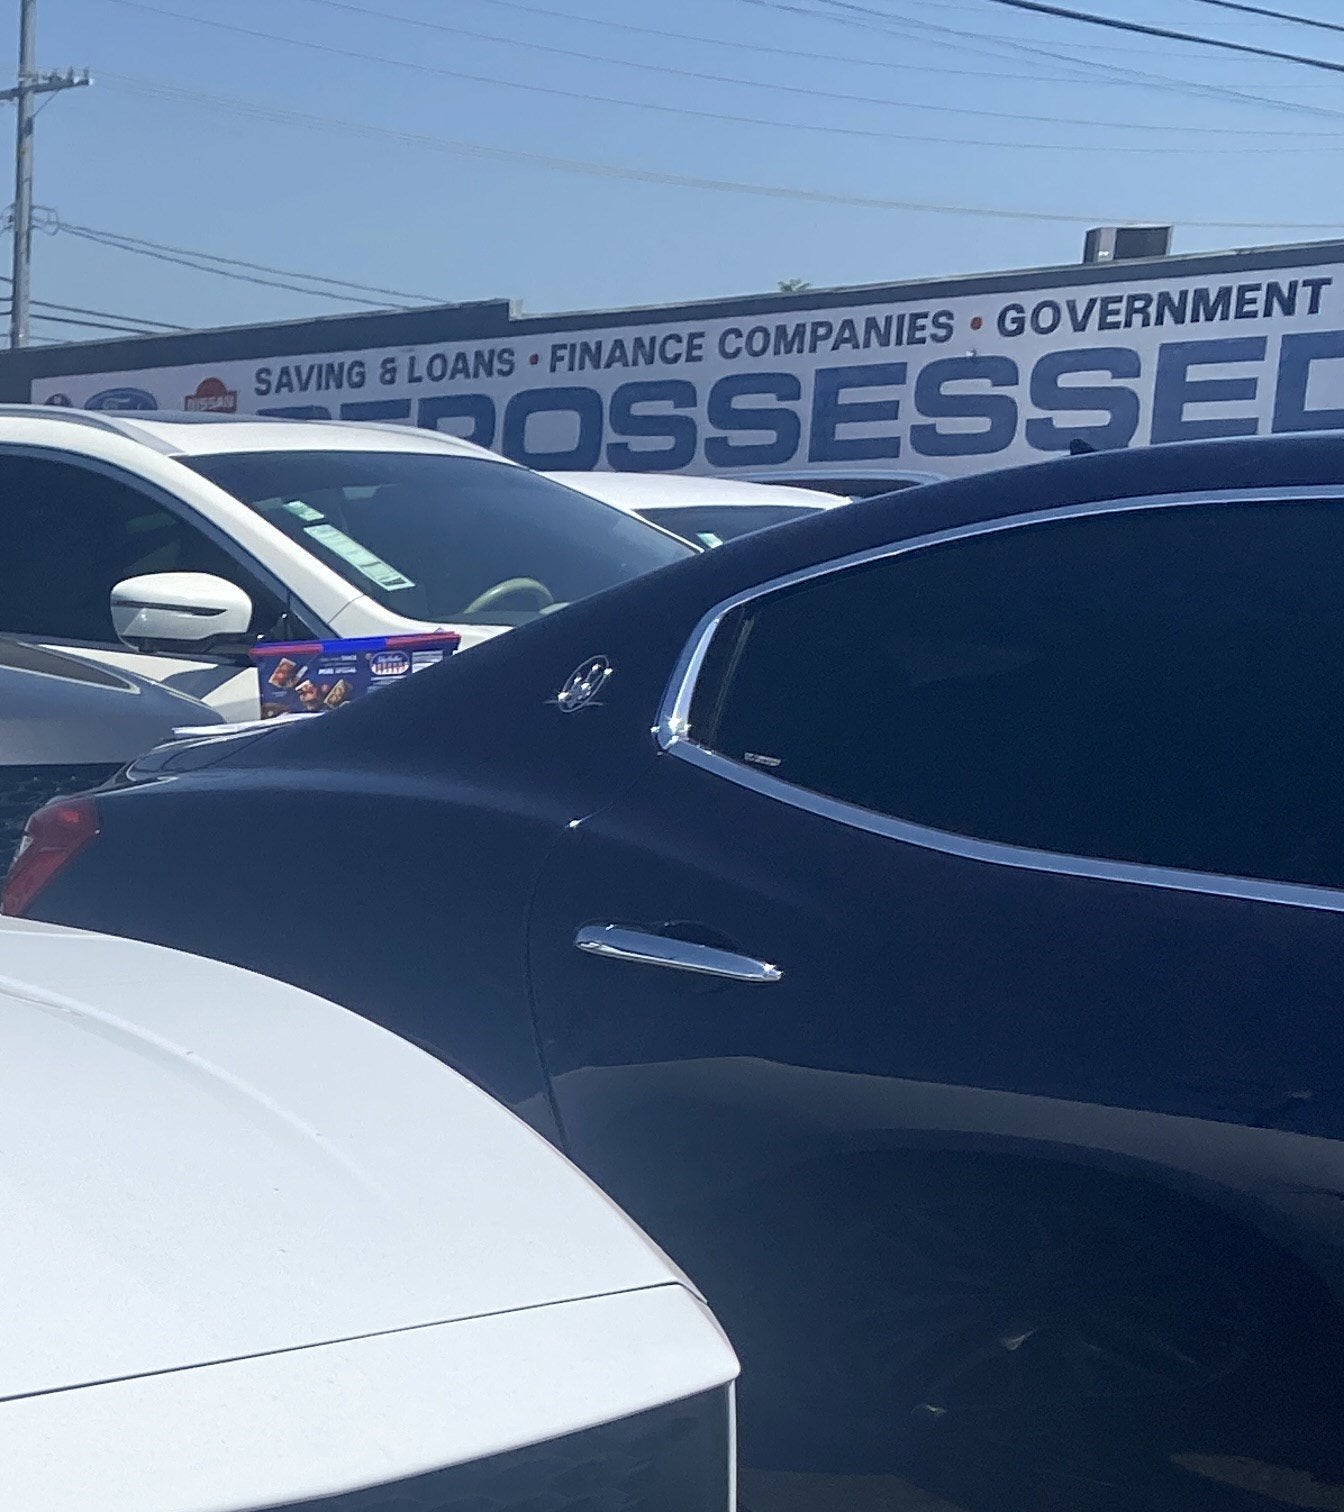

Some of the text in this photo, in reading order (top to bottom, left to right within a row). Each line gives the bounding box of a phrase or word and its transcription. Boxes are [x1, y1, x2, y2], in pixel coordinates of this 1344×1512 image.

[254, 276, 1334, 396] SAVING & LOANS FINANCE COMPANIES GOVERNMENT
